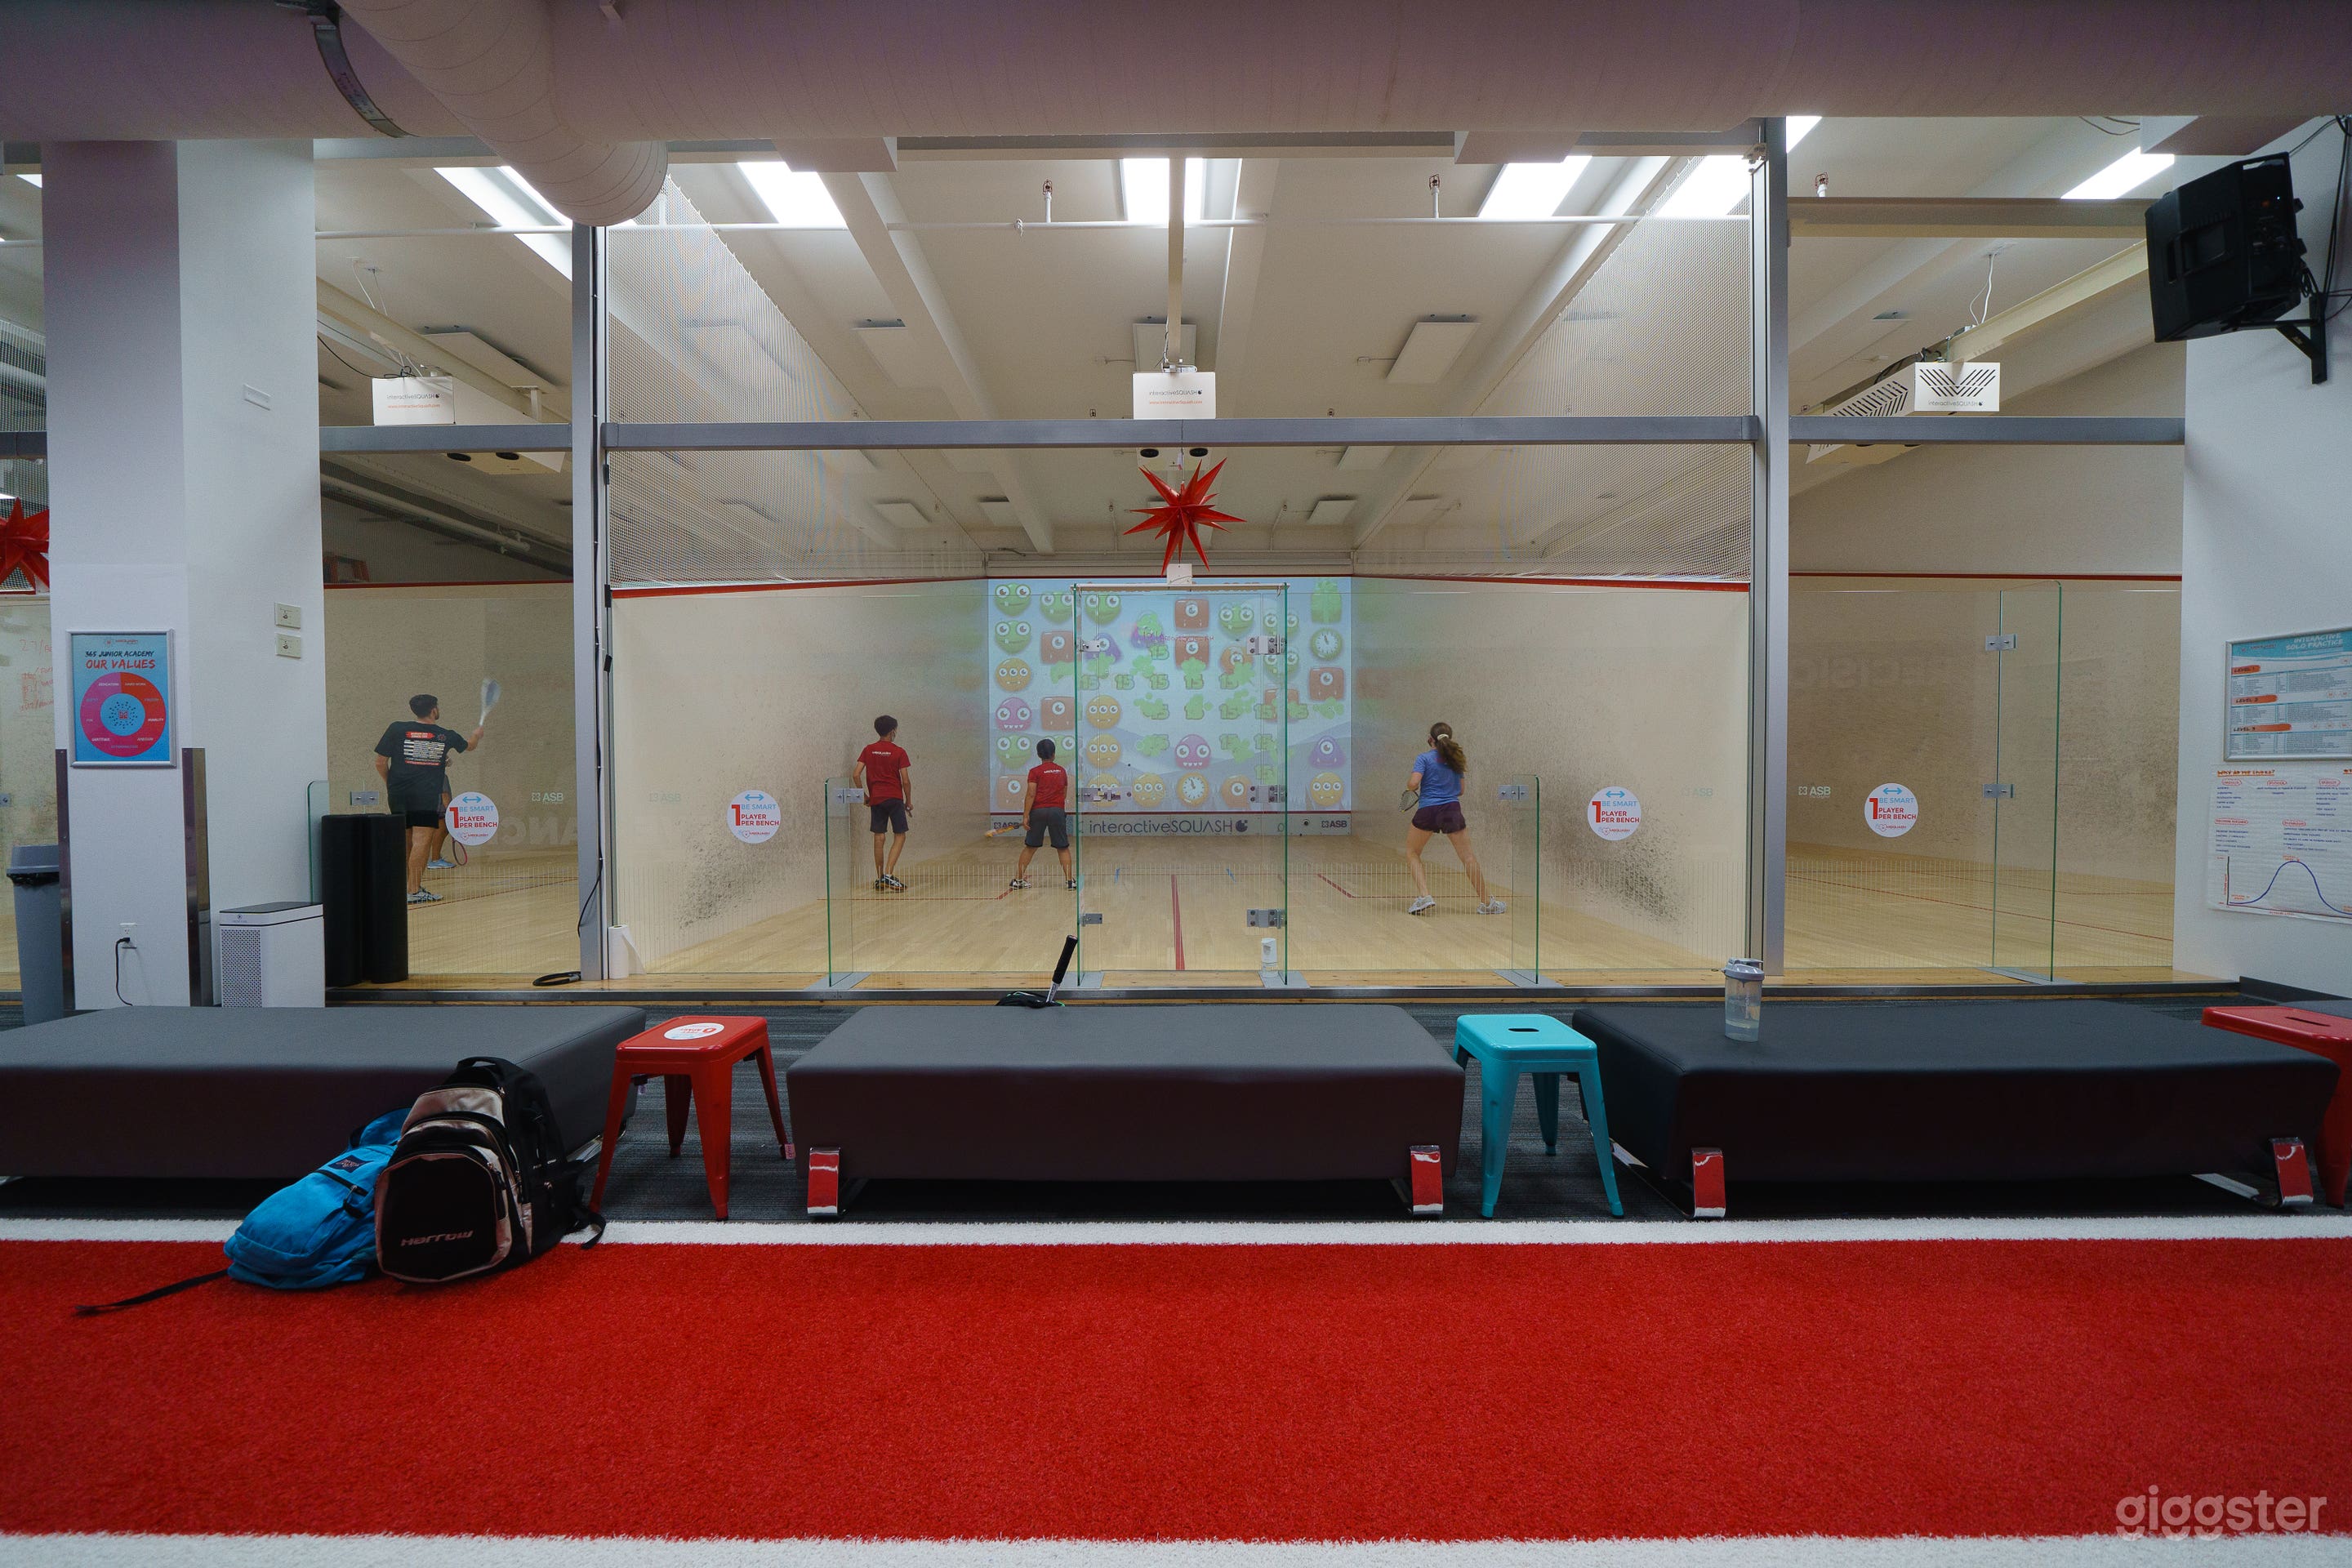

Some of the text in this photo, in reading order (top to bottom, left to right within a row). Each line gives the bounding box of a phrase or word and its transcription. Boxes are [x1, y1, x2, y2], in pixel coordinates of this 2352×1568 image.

[2286, 643, 2306, 651] SOLO
[2308, 638, 2344, 648] PRACTICE
[86, 659, 156, 670] OUR VALUES
[1150, 675, 1169, 690] 15
[542, 792, 564, 801] ASB
[1810, 786, 1831, 795] ASB
[731, 804, 741, 826] 1
[1592, 801, 1601, 822] 1
[1869, 798, 1878, 819] 1
[449, 807, 459, 828] 1
[1089, 820, 1232, 834] interactiveSQUASH
[401, 1231, 474, 1246] Harrow
